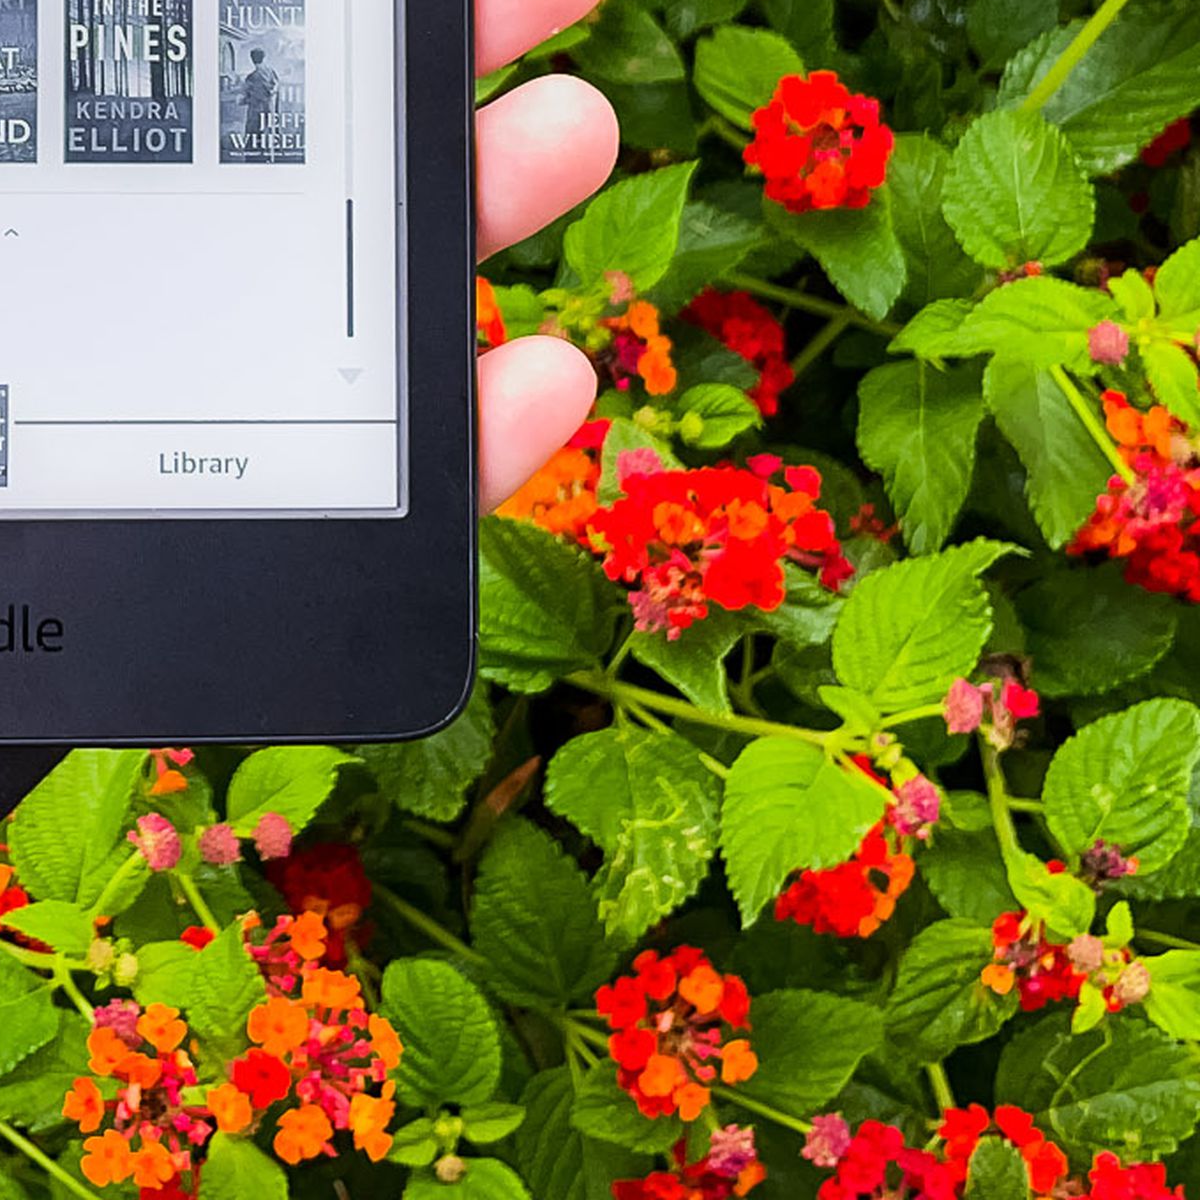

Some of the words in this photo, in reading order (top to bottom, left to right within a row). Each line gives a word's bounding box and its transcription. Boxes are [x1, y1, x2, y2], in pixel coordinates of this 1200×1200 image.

[69, 24, 187, 62] PINES
[76, 101, 179, 120] KENDRA
[69, 128, 187, 152] ELLIOT
[158, 453, 249, 479] Library
